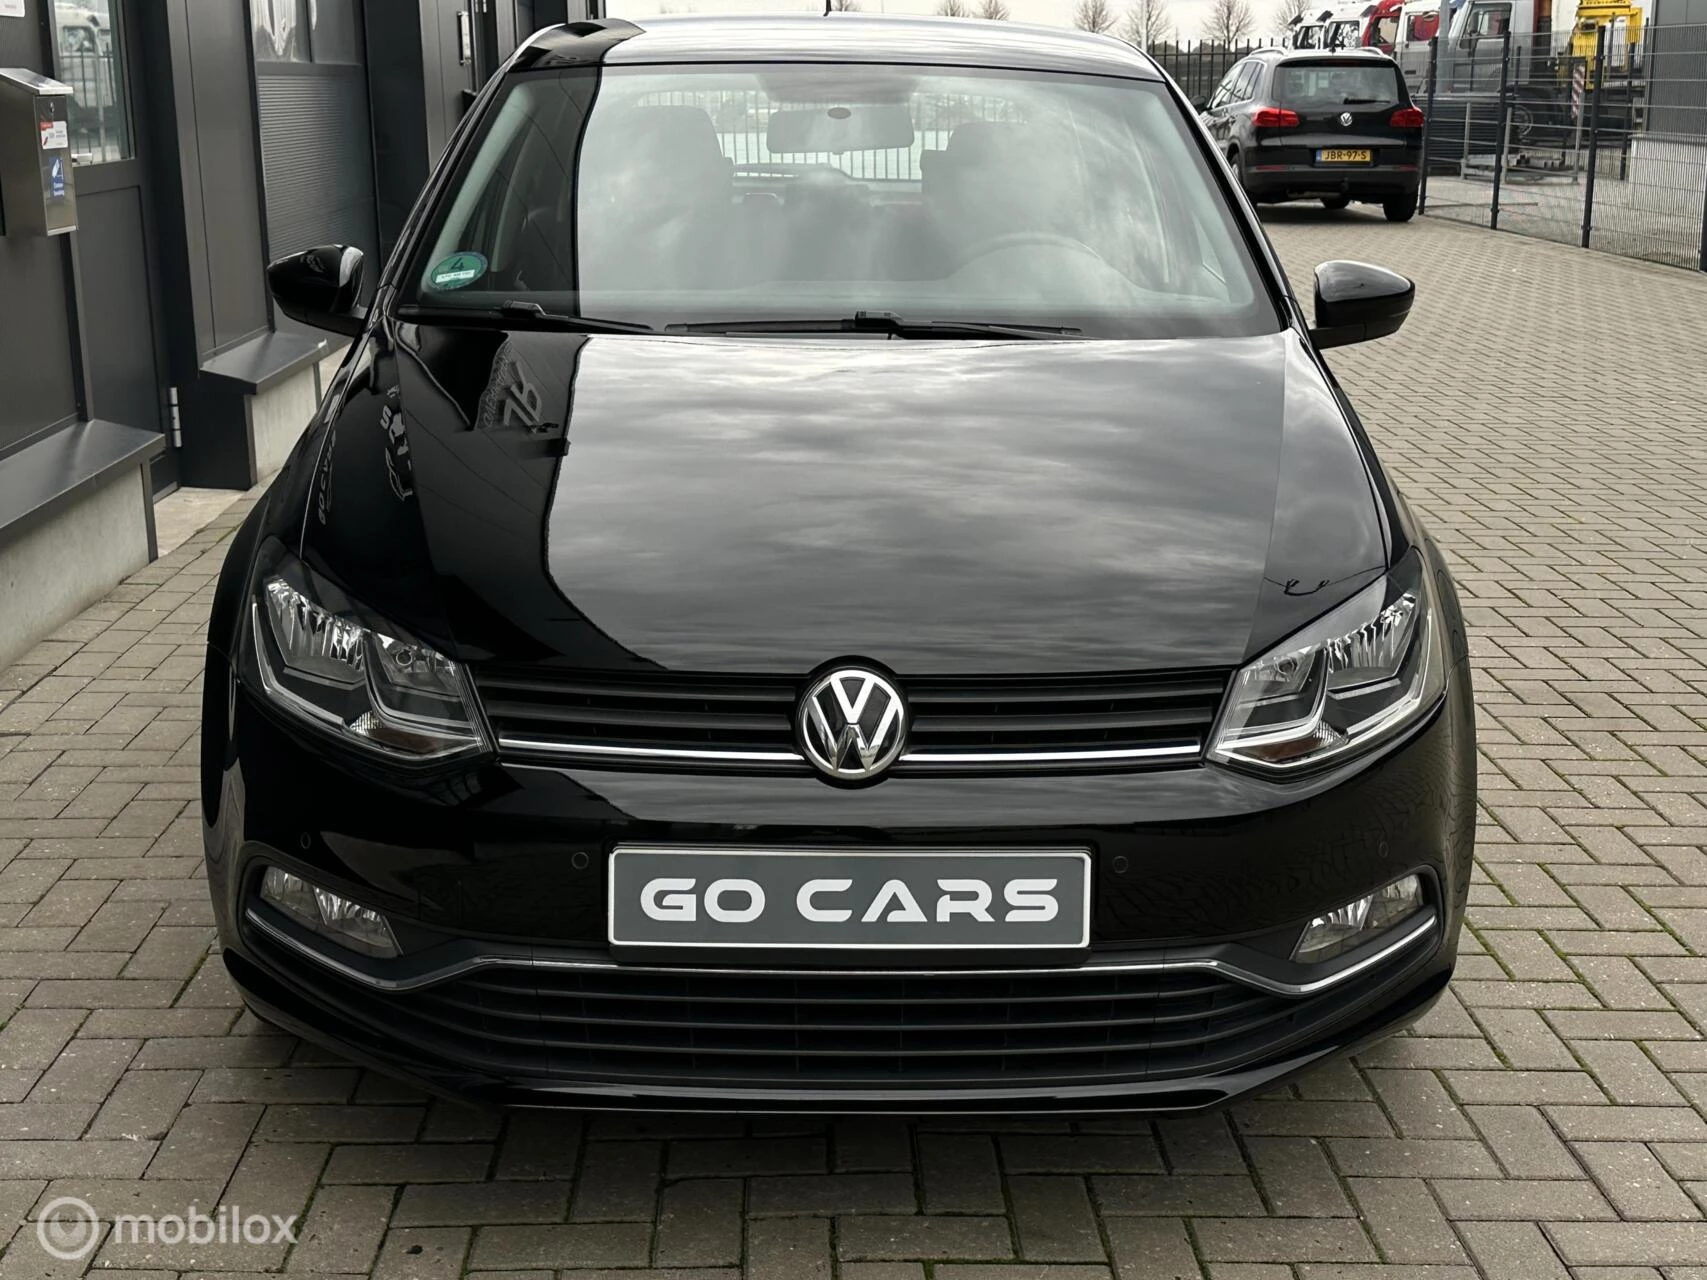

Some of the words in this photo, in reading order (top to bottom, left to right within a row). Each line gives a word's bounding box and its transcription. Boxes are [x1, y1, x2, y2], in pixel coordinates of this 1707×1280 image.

[1325, 150, 1367, 160] JBR-97-S
[450, 256, 465, 271] 4
[640, 877, 766, 923] GO
[796, 878, 1059, 923] CARS
